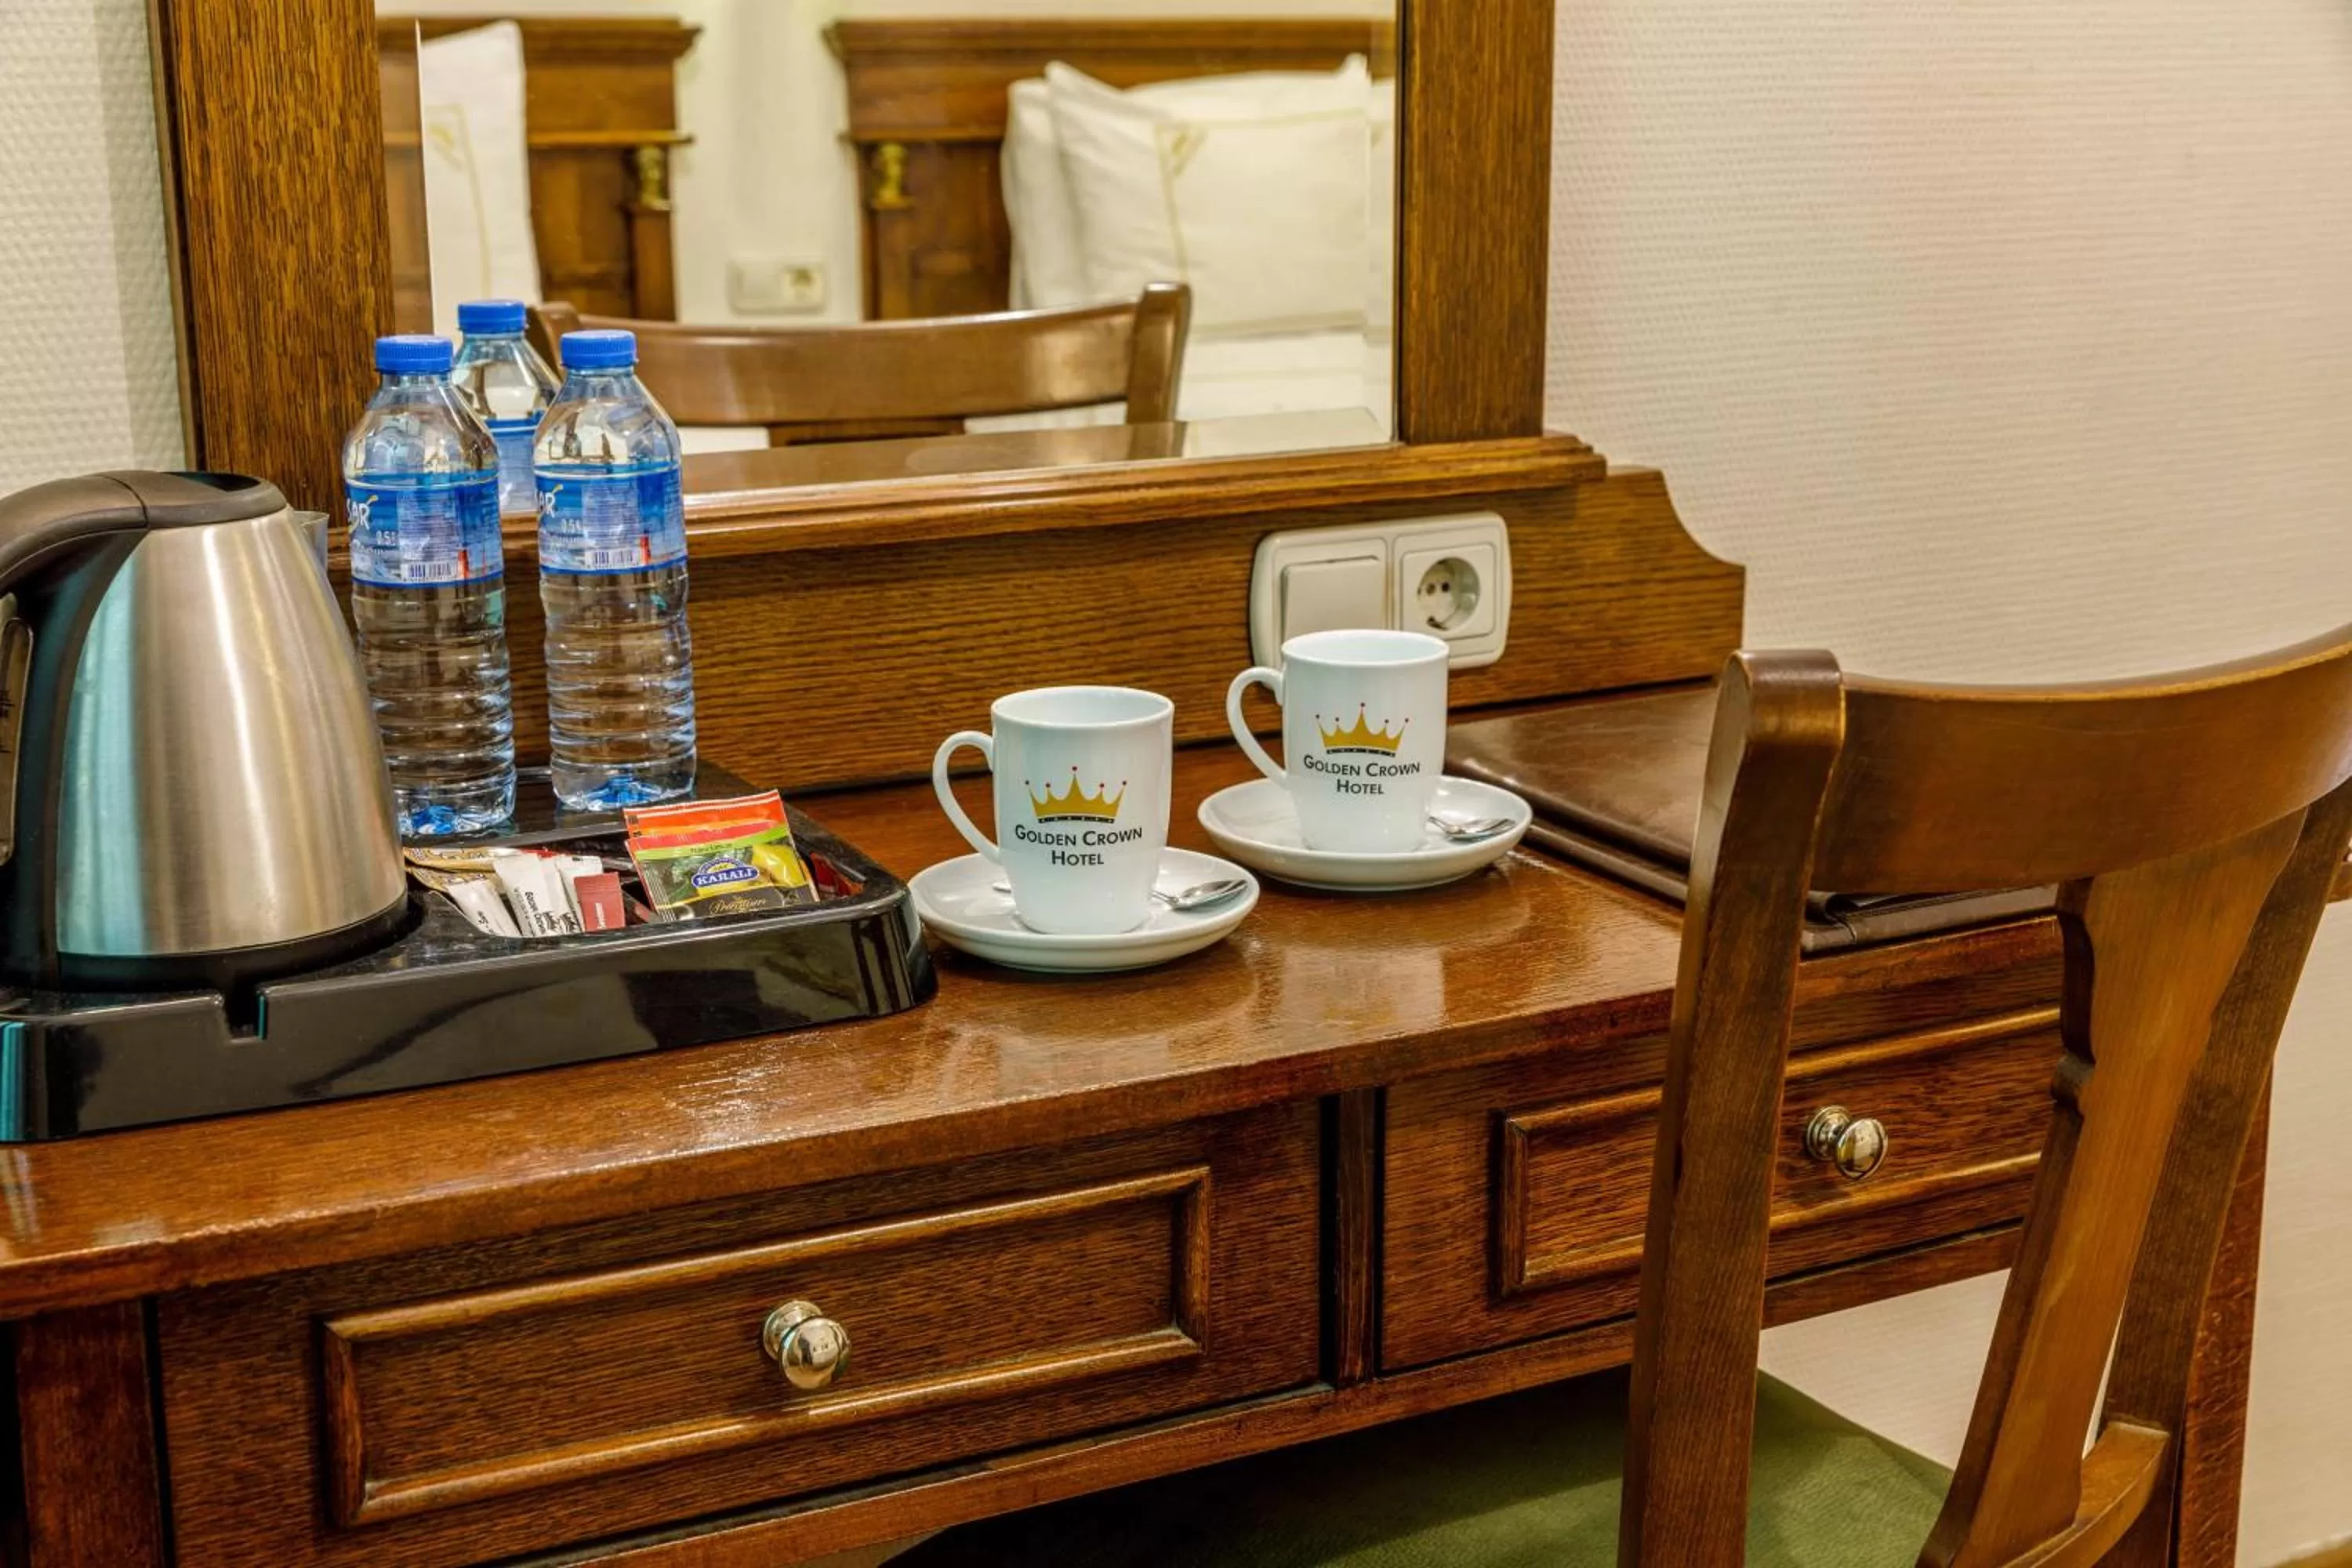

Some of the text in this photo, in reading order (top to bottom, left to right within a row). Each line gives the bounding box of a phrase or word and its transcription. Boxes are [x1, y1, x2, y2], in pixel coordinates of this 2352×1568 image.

[1304, 754, 1420, 777] GOLDEN CROWN
[1337, 779, 1384, 794] HOTEL
[1015, 824, 1142, 847] GOLDEN CROWN
[1051, 850, 1104, 866] HOTEL
